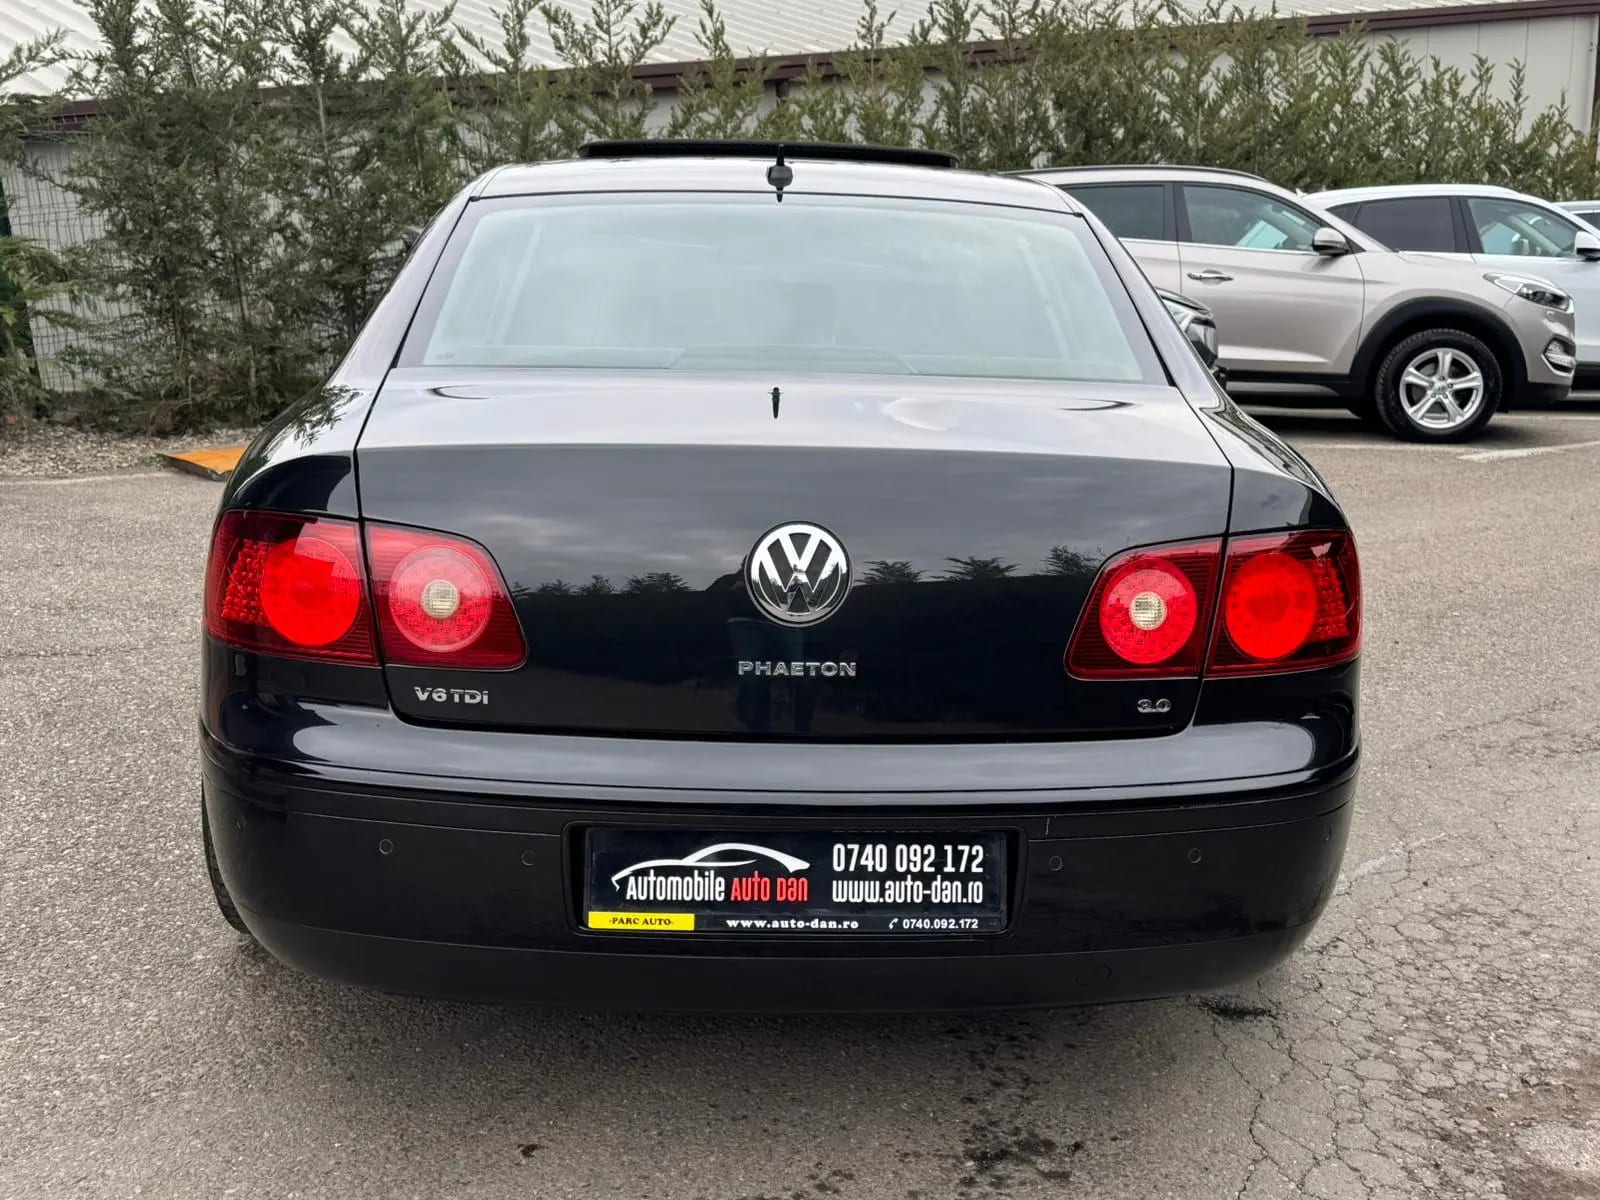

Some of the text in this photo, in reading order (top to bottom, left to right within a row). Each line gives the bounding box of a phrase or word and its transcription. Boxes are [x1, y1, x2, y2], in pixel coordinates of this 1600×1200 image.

[737, 661, 857, 677] PHAETON
[832, 843, 984, 873] 0740 092 172
[626, 869, 725, 901] Automobile
[832, 874, 983, 904] www.auto-dan.ro
[726, 918, 859, 929] www.auto-dan.ro
[902, 918, 979, 930] 0740.092.172
